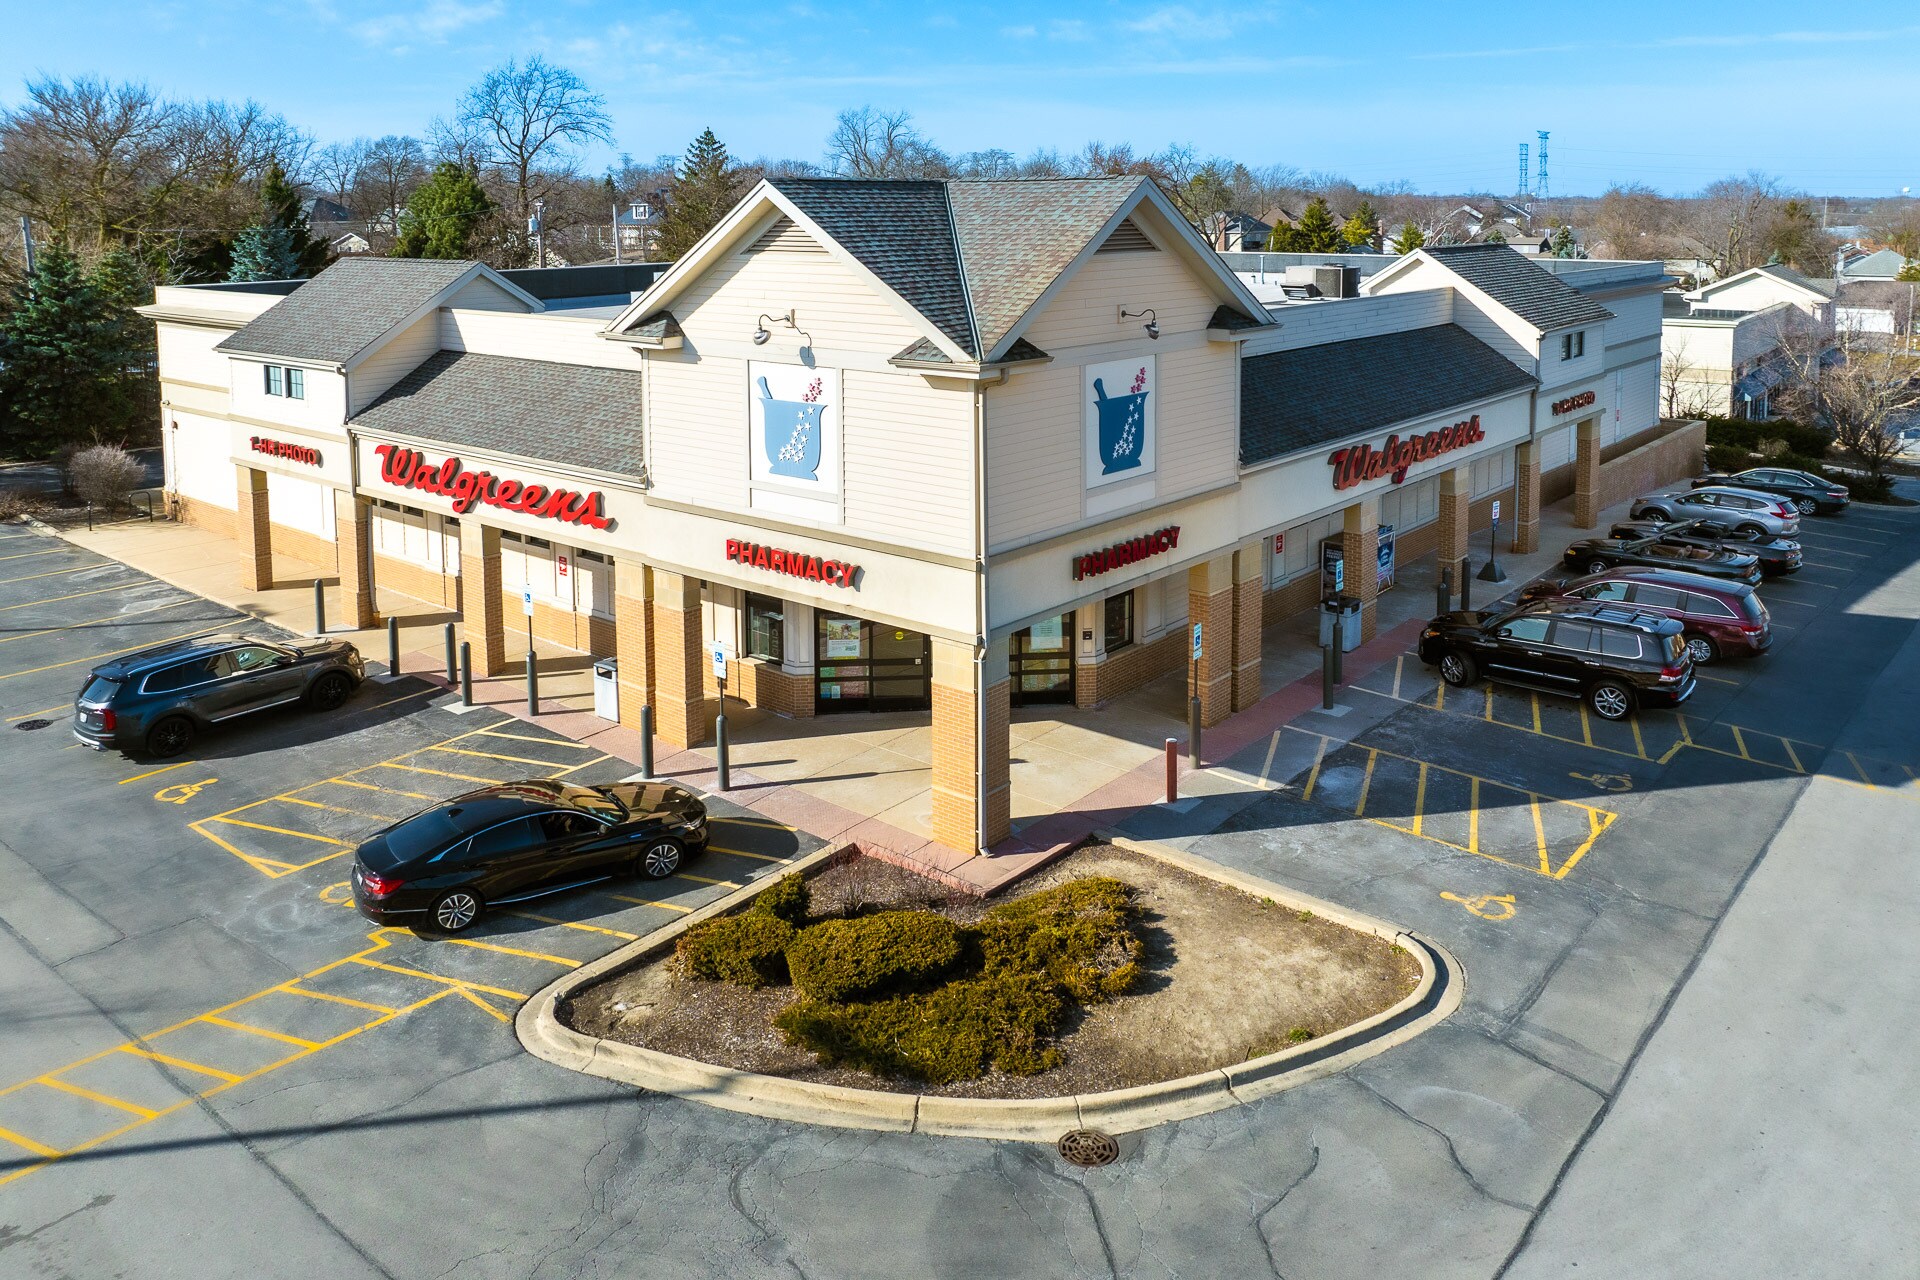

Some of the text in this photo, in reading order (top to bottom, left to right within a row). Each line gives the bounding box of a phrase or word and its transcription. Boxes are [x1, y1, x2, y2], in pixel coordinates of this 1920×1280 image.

[249, 436, 319, 466] 1-HR PHOTO
[1328, 415, 1485, 490] Walgreens
[375, 444, 611, 531] Walgreens
[726, 539, 858, 589] PHARMACY
[1074, 526, 1181, 581] PHARMACY
